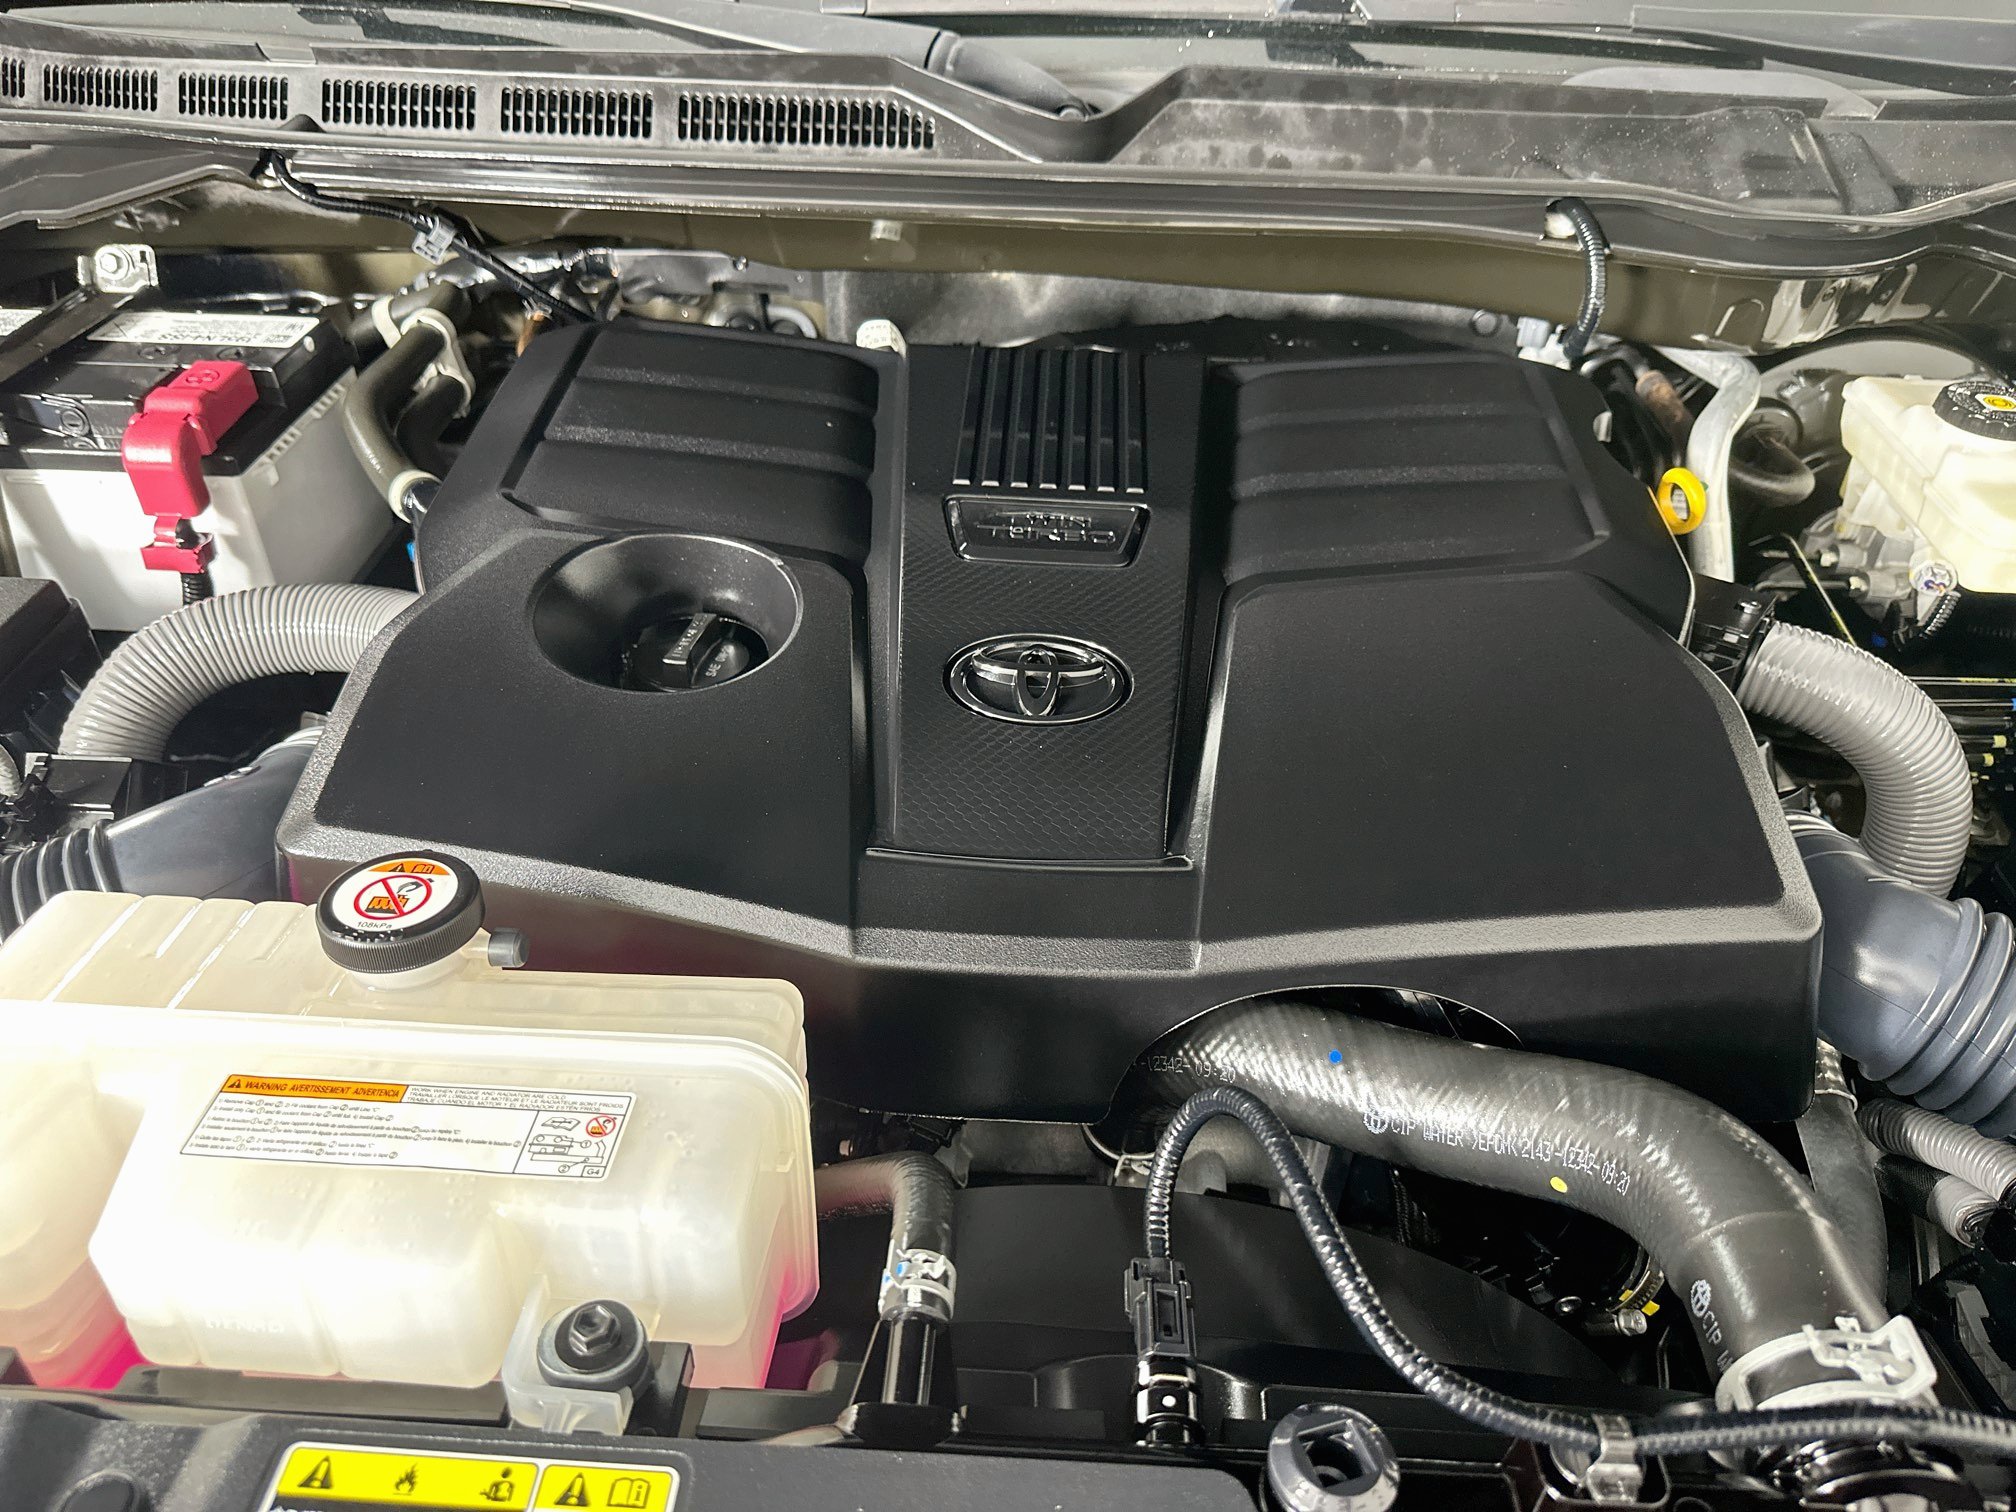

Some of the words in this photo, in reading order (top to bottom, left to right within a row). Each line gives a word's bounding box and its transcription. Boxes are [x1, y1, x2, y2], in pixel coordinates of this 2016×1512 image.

[356, 920, 393, 930] 108kPa
[245, 1081, 288, 1092] WARNING
[289, 1083, 352, 1095] AVERTISSEMENT
[353, 1087, 401, 1098] ADVERTENCIA
[539, 1098, 578, 1106] RADIATEUR
[1422, 1125, 1465, 1148] WATER
[587, 1168, 601, 1176] G4
